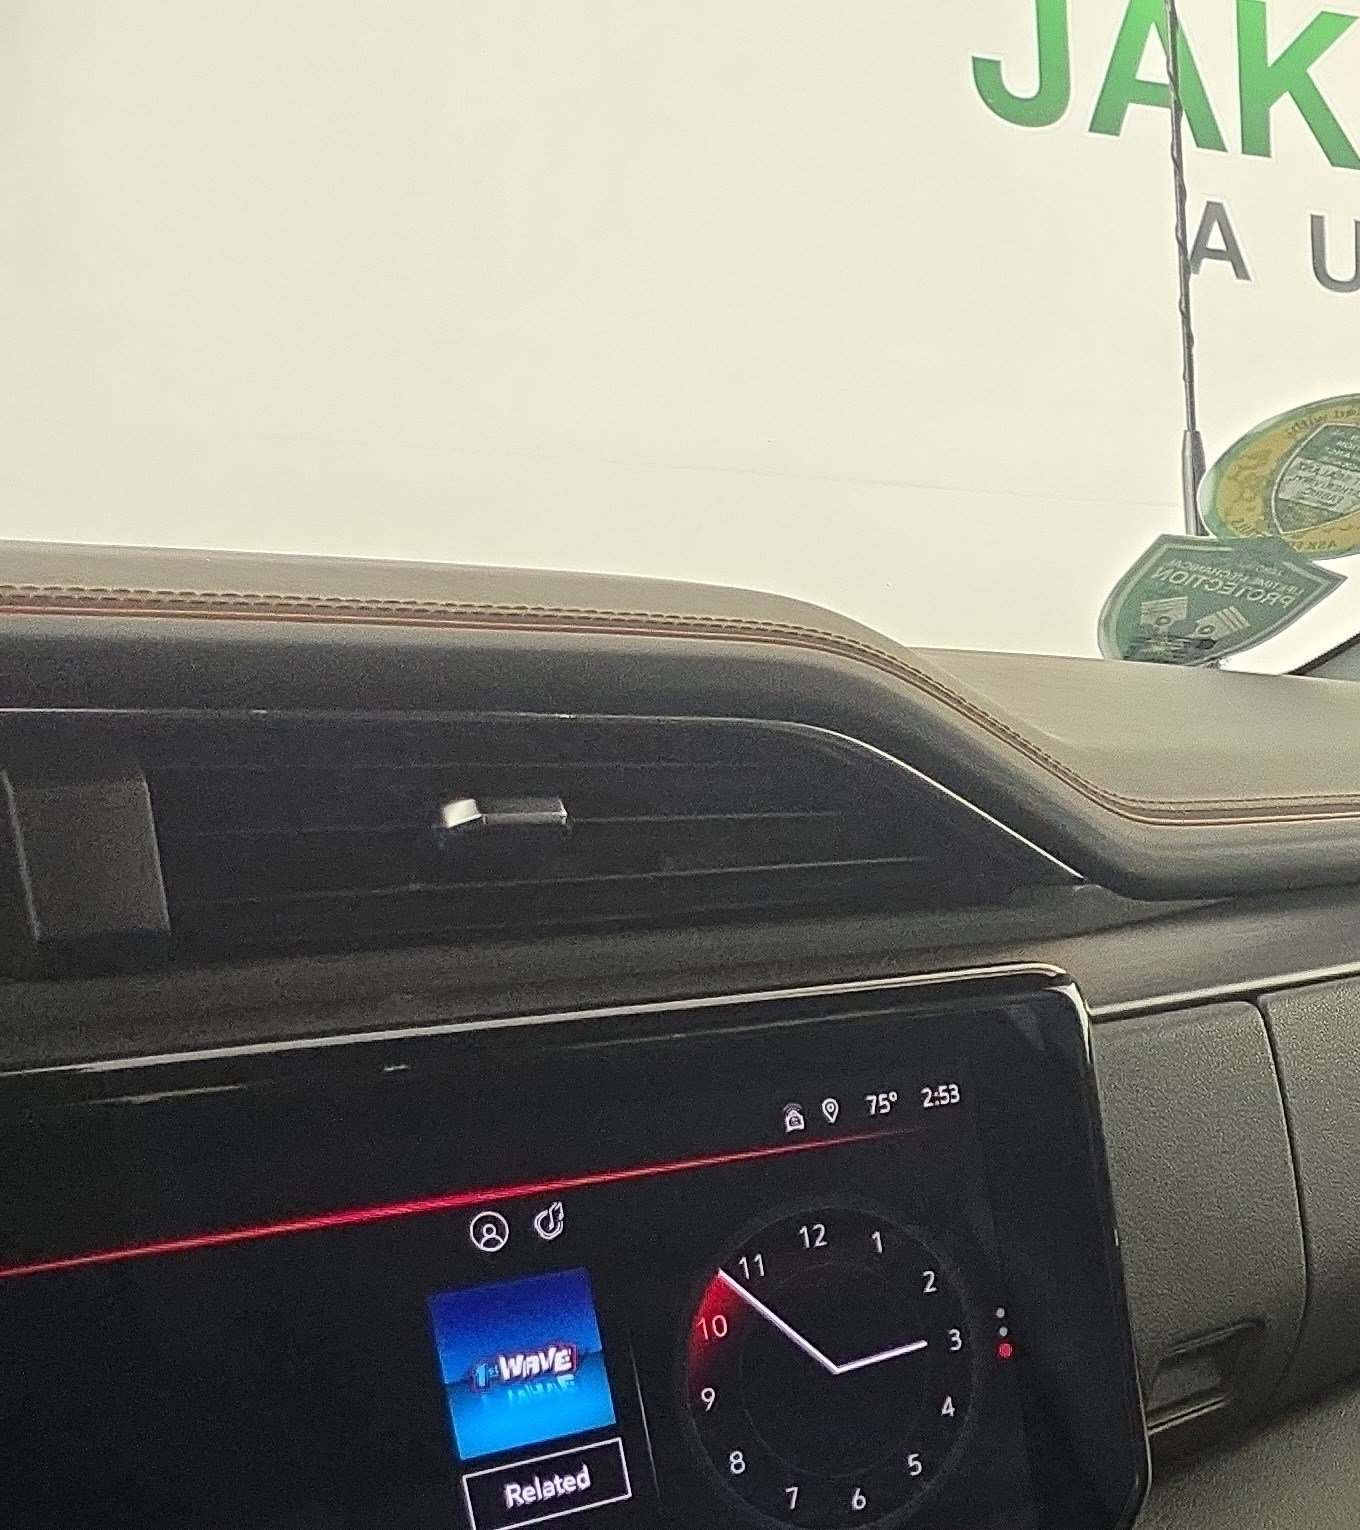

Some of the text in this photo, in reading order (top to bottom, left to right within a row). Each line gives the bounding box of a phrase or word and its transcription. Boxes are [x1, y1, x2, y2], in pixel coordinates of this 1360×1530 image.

[866, 1084, 960, 1116] 75° 2:53
[799, 1223, 828, 1249] 12
[871, 1230, 883, 1253] 1
[738, 1253, 766, 1280] 11
[922, 1270, 938, 1293] 2
[697, 1314, 728, 1341] 10
[948, 1328, 963, 1351] 3
[700, 1387, 716, 1411] 9
[941, 1396, 956, 1417] 4
[729, 1450, 746, 1474] 8
[907, 1453, 923, 1476] 5
[505, 1463, 592, 1510] Related
[784, 1486, 799, 1510] 7
[851, 1487, 867, 1510] 6
